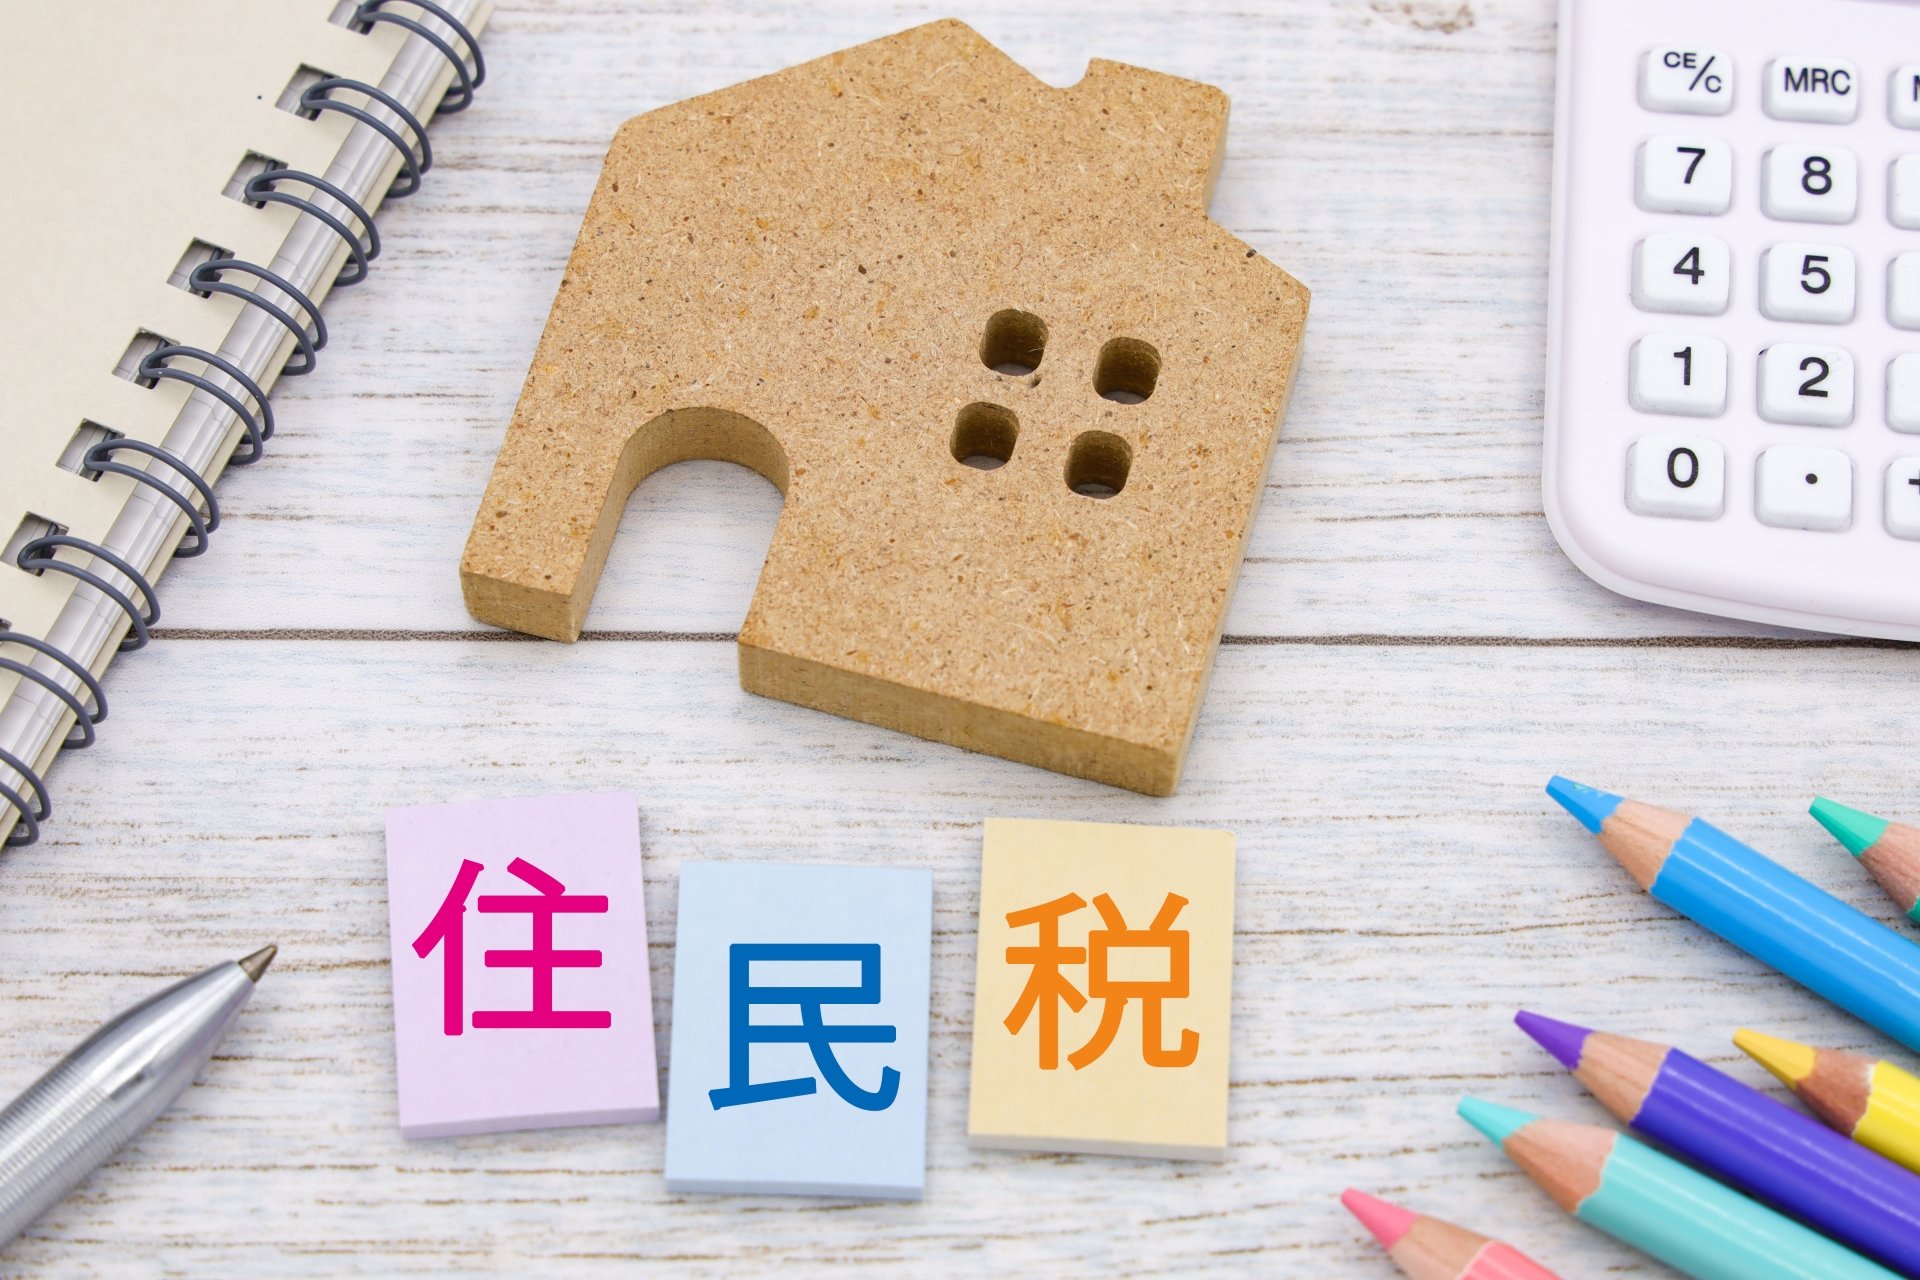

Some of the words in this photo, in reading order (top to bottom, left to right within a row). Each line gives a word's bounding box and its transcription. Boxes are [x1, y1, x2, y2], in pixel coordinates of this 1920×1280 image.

[1784, 67, 1851, 96] MRC
[1677, 147, 1706, 185] 7
[1801, 157, 1833, 196] 8
[1673, 247, 1705, 285] 4
[1800, 255, 1831, 295] 5
[1674, 346, 1692, 386] 1
[1798, 357, 1830, 398] 2
[1667, 448, 1699, 488] 0
[412, 857, 612, 1036] 住
[1003, 892, 1200, 1070] 税
[709, 943, 901, 1111] 民
